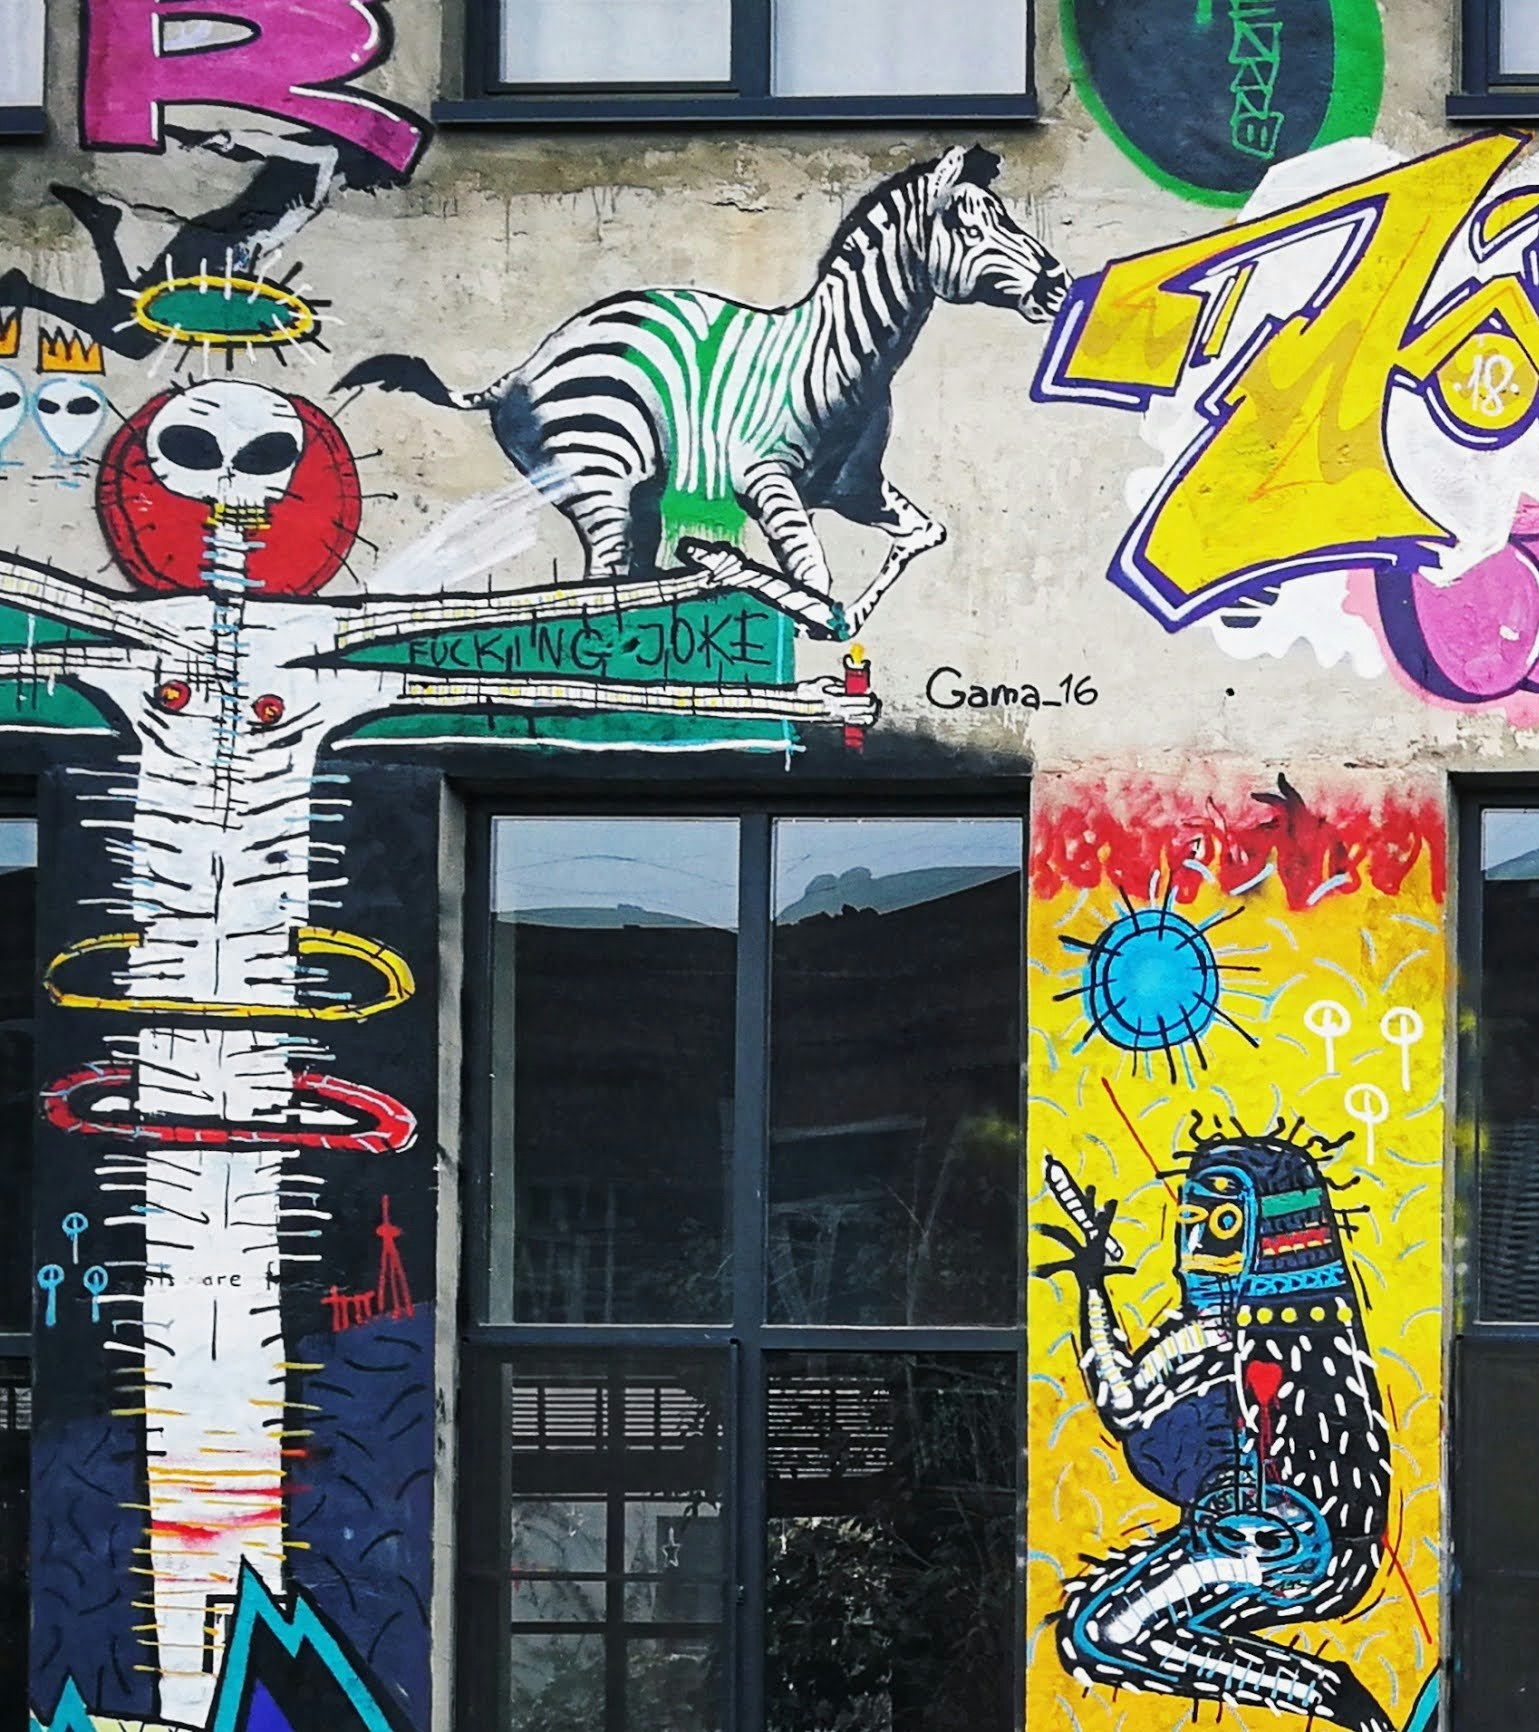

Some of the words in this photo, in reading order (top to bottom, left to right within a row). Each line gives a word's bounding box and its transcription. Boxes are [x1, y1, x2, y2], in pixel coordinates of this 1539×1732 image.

[408, 625, 606, 672] FUCKING
[637, 610, 772, 668] JOKE
[925, 666, 1099, 711] Gama_16
